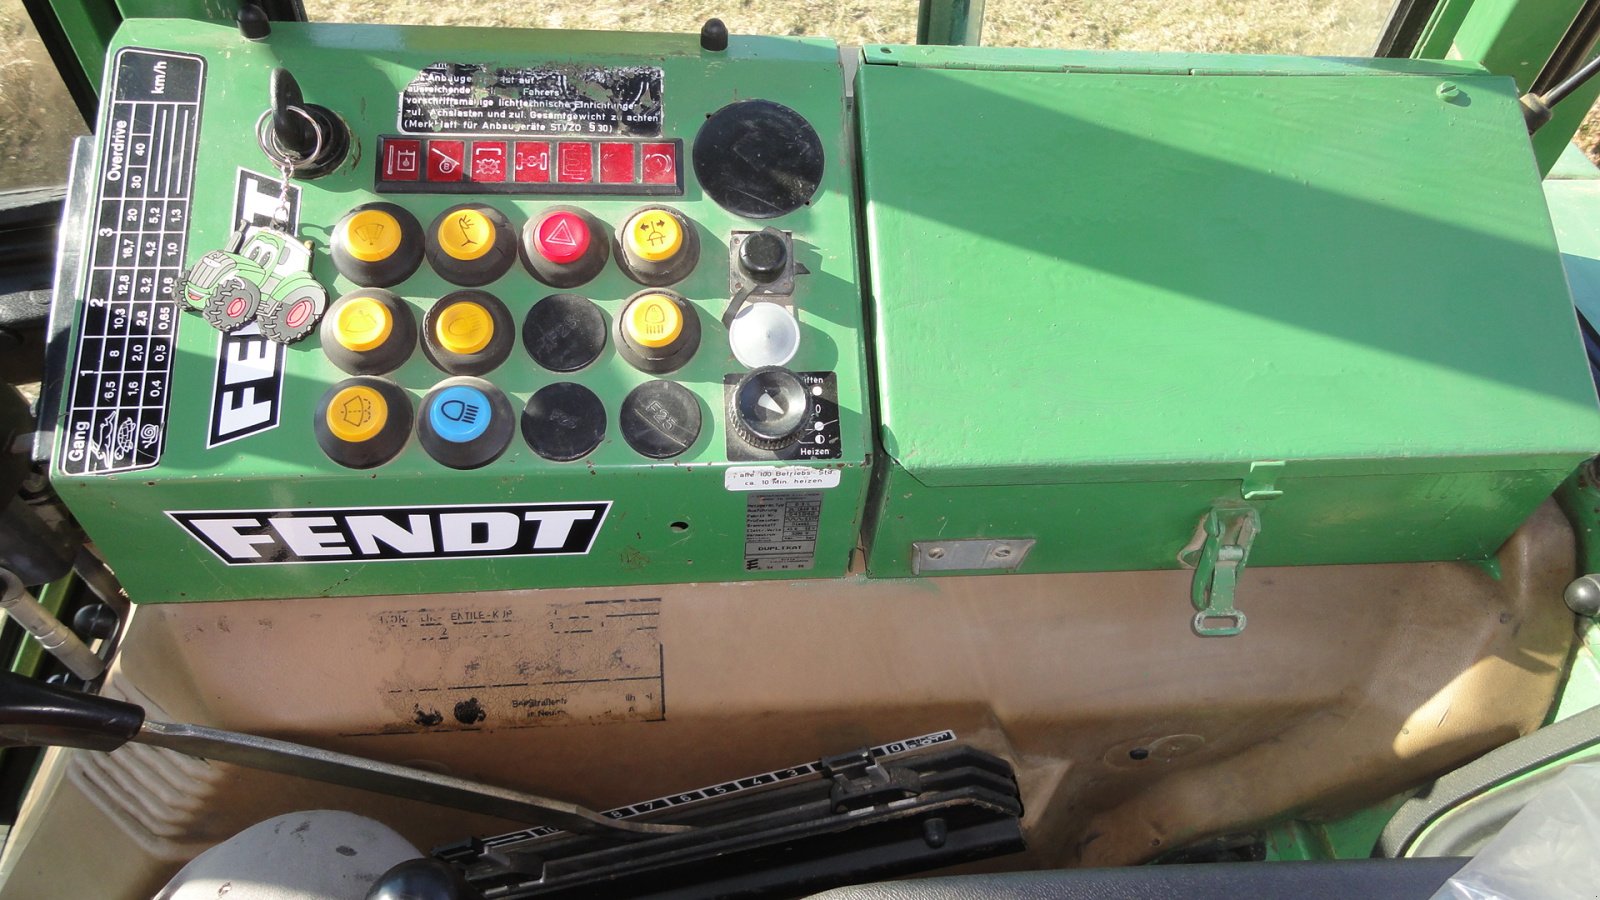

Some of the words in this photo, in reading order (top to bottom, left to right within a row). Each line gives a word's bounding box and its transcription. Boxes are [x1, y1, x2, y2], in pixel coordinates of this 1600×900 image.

[151, 61, 167, 94] km/h
[518, 76, 534, 84] auf
[523, 87, 560, 96] Fahrers
[406, 97, 494, 107] vorschriftsmäige
[430, 109, 484, 118] Achslasten
[529, 111, 606, 122] Gesamtgewicht
[626, 114, 659, 122] achten
[463, 121, 478, 129] für
[550, 123, 582, 131] STVZO
[589, 122, 596, 132] §
[597, 124, 613, 133] 30)
[135, 143, 146, 156] 40
[131, 175, 142, 189] 30
[127, 208, 138, 221] 20
[149, 207, 161, 223] 5,2
[171, 208, 182, 223] 1,3
[145, 241, 157, 257] 4,2
[167, 242, 178, 257] 1,0
[68, 421, 90, 462] Gang
[90, 298, 104, 307] 2
[99, 227, 113, 237] 3
[106, 120, 127, 181] Overdrive
[118, 275, 130, 295] 12,8
[140, 277, 153, 293] 3,2
[162, 277, 174, 294] 0,8
[218, 178, 291, 437] FET
[114, 308, 127, 329] 10,3
[132, 345, 144, 361] 2,0
[155, 345, 167, 362] 0,5
[104, 381, 117, 399] 6,5
[128, 381, 139, 396] 1,6
[150, 380, 162, 397] 0,4
[645, 401, 678, 431] F25
[815, 404, 821, 413] 0
[800, 448, 830, 456] Heizen
[188, 509, 596, 559] FENDT
[611, 810, 623, 818] 8
[719, 786, 727, 794] 5
[752, 776, 763, 785] 4
[788, 769, 798, 777] 3
[890, 744, 901, 752] 0
